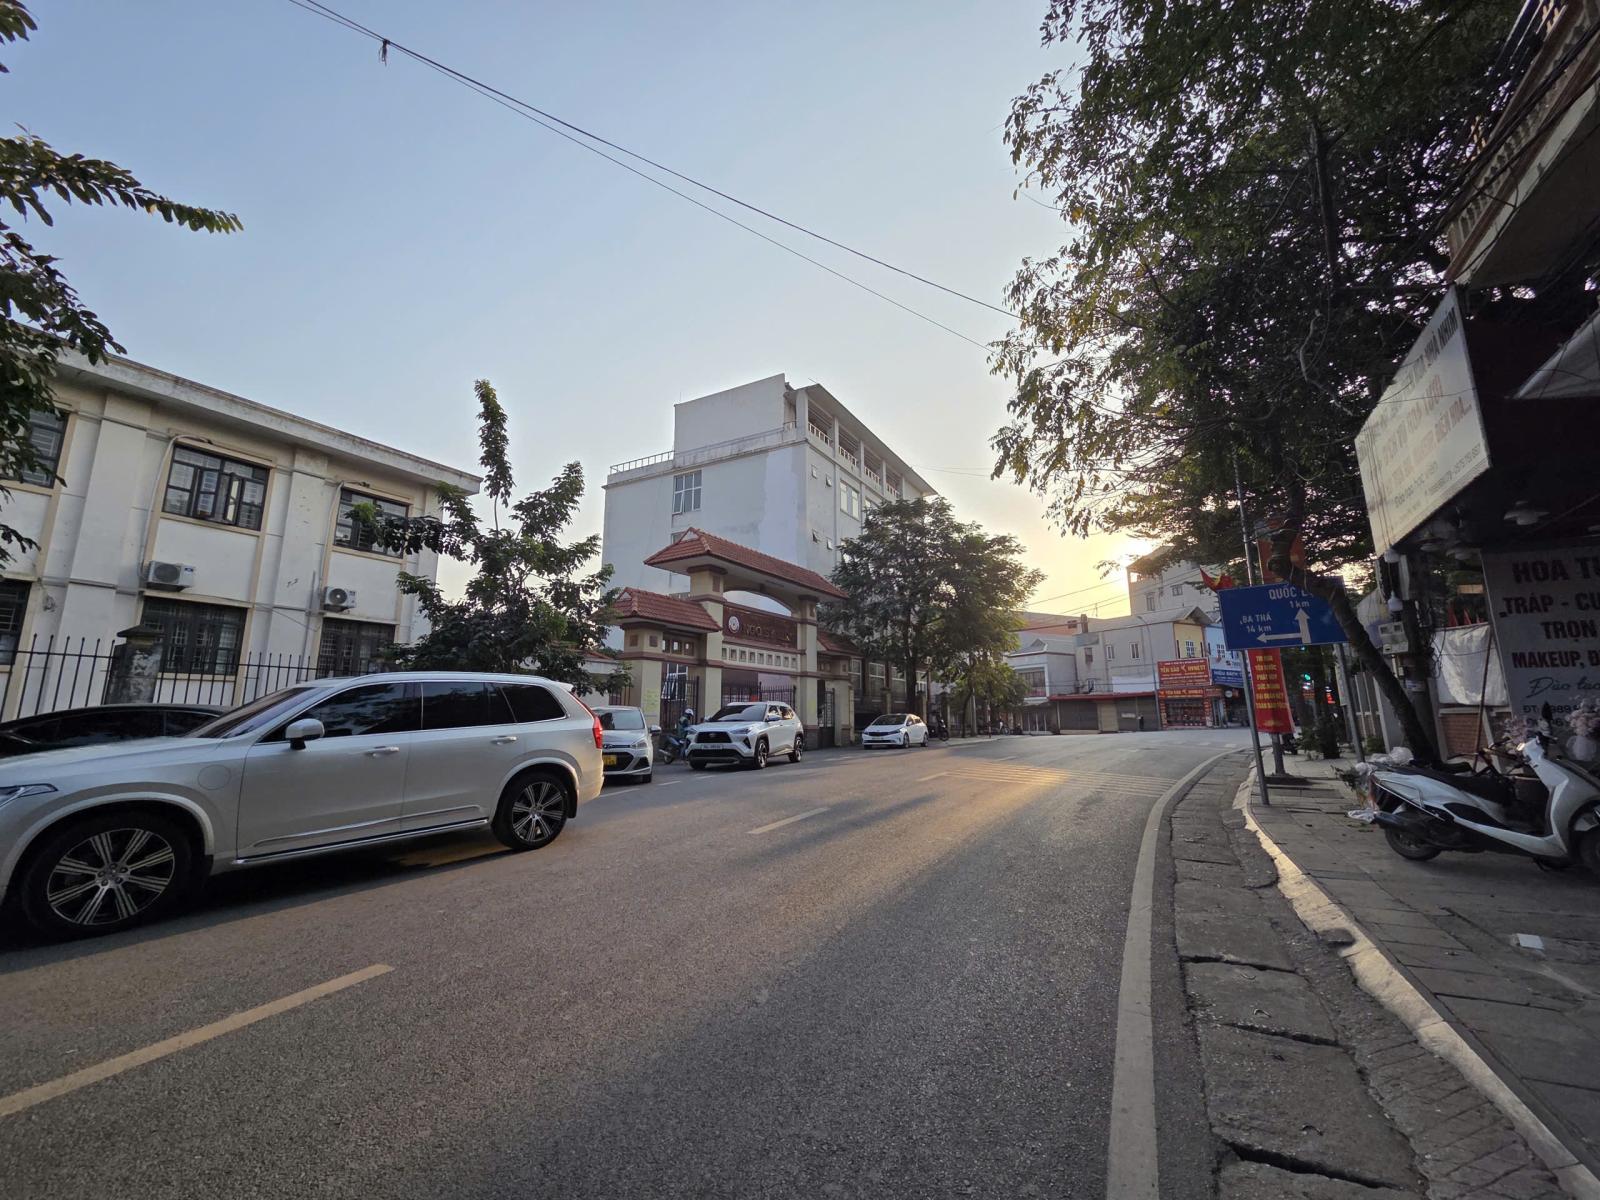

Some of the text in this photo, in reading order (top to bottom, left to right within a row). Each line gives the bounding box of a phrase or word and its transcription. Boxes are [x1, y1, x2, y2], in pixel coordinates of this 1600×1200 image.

[1512, 560, 1569, 583] HOA
[1269, 579, 1297, 600] QUỐC
[1242, 615, 1254, 624] BA
[1541, 620, 1598, 642] TRỌN
[1511, 650, 1585, 669] MAKEUP,
